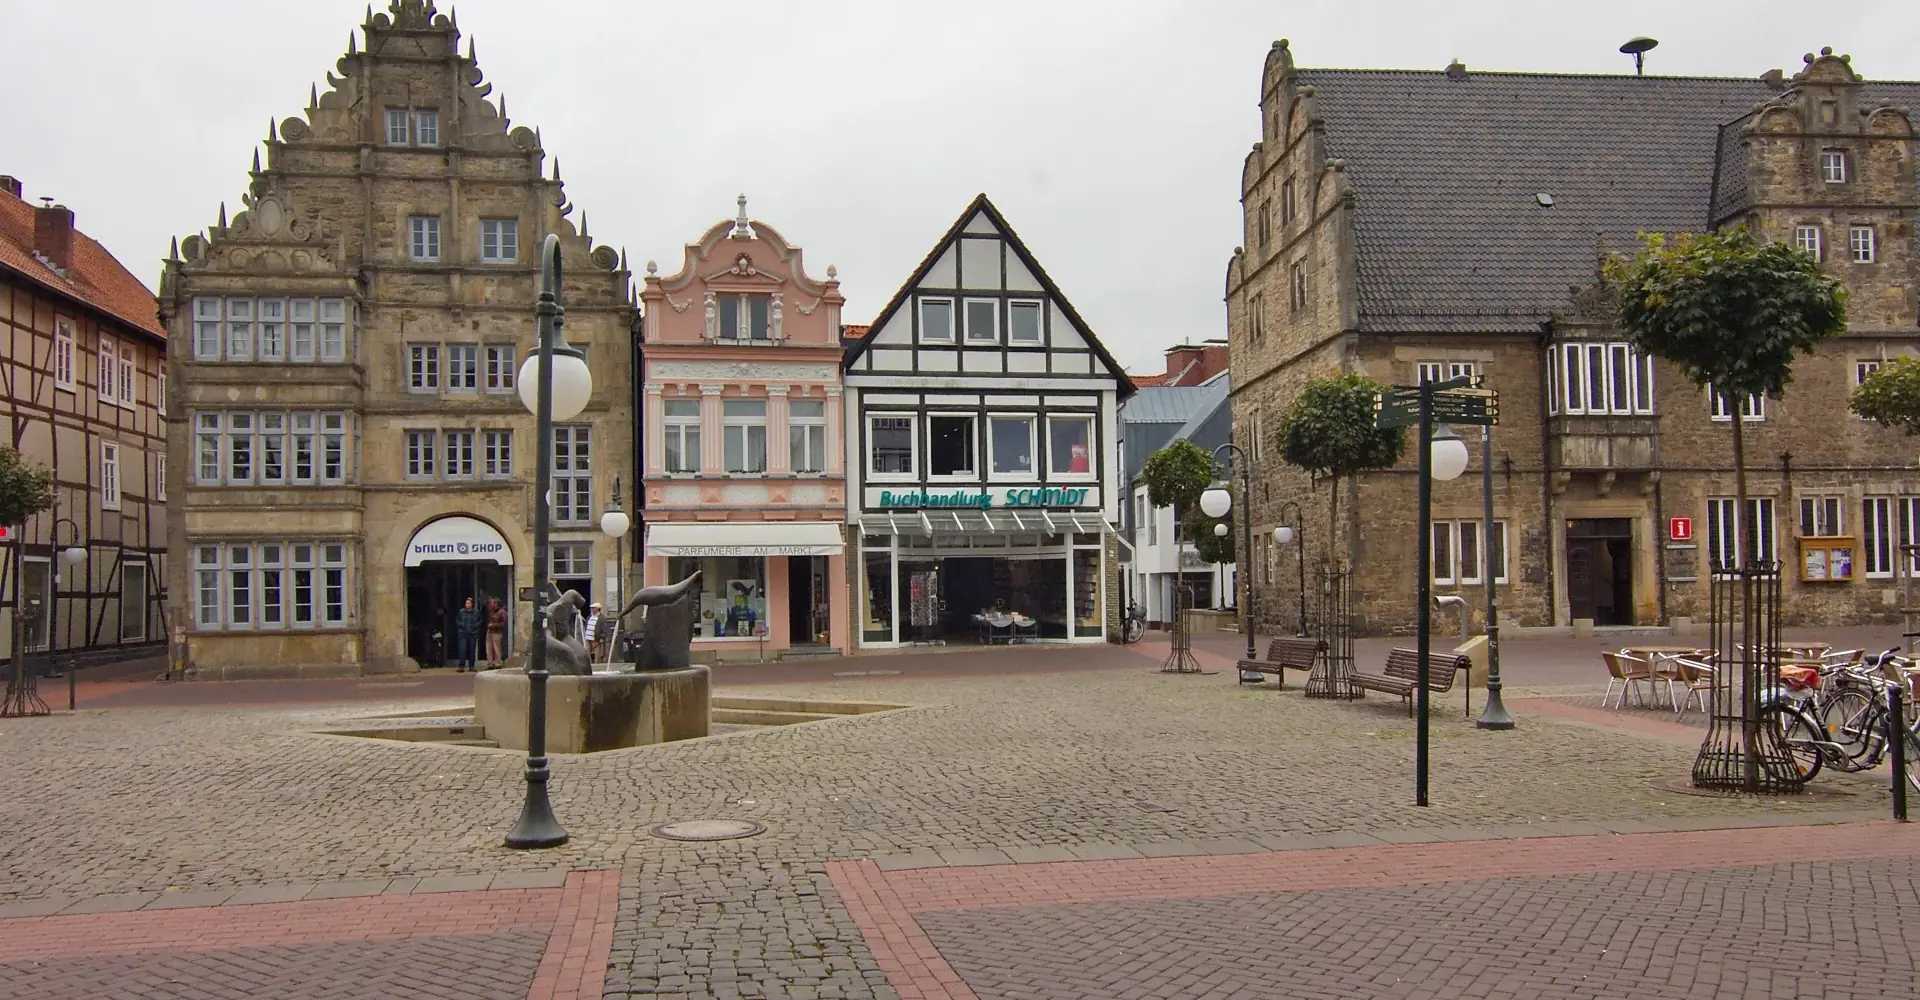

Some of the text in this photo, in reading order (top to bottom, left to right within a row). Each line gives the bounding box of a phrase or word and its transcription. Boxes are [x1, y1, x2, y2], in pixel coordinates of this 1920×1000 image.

[879, 490, 994, 510] Buchhandlung
[471, 543, 503, 553] SHOP
[753, 547, 768, 555] AM
[779, 546, 813, 555] MARKT
